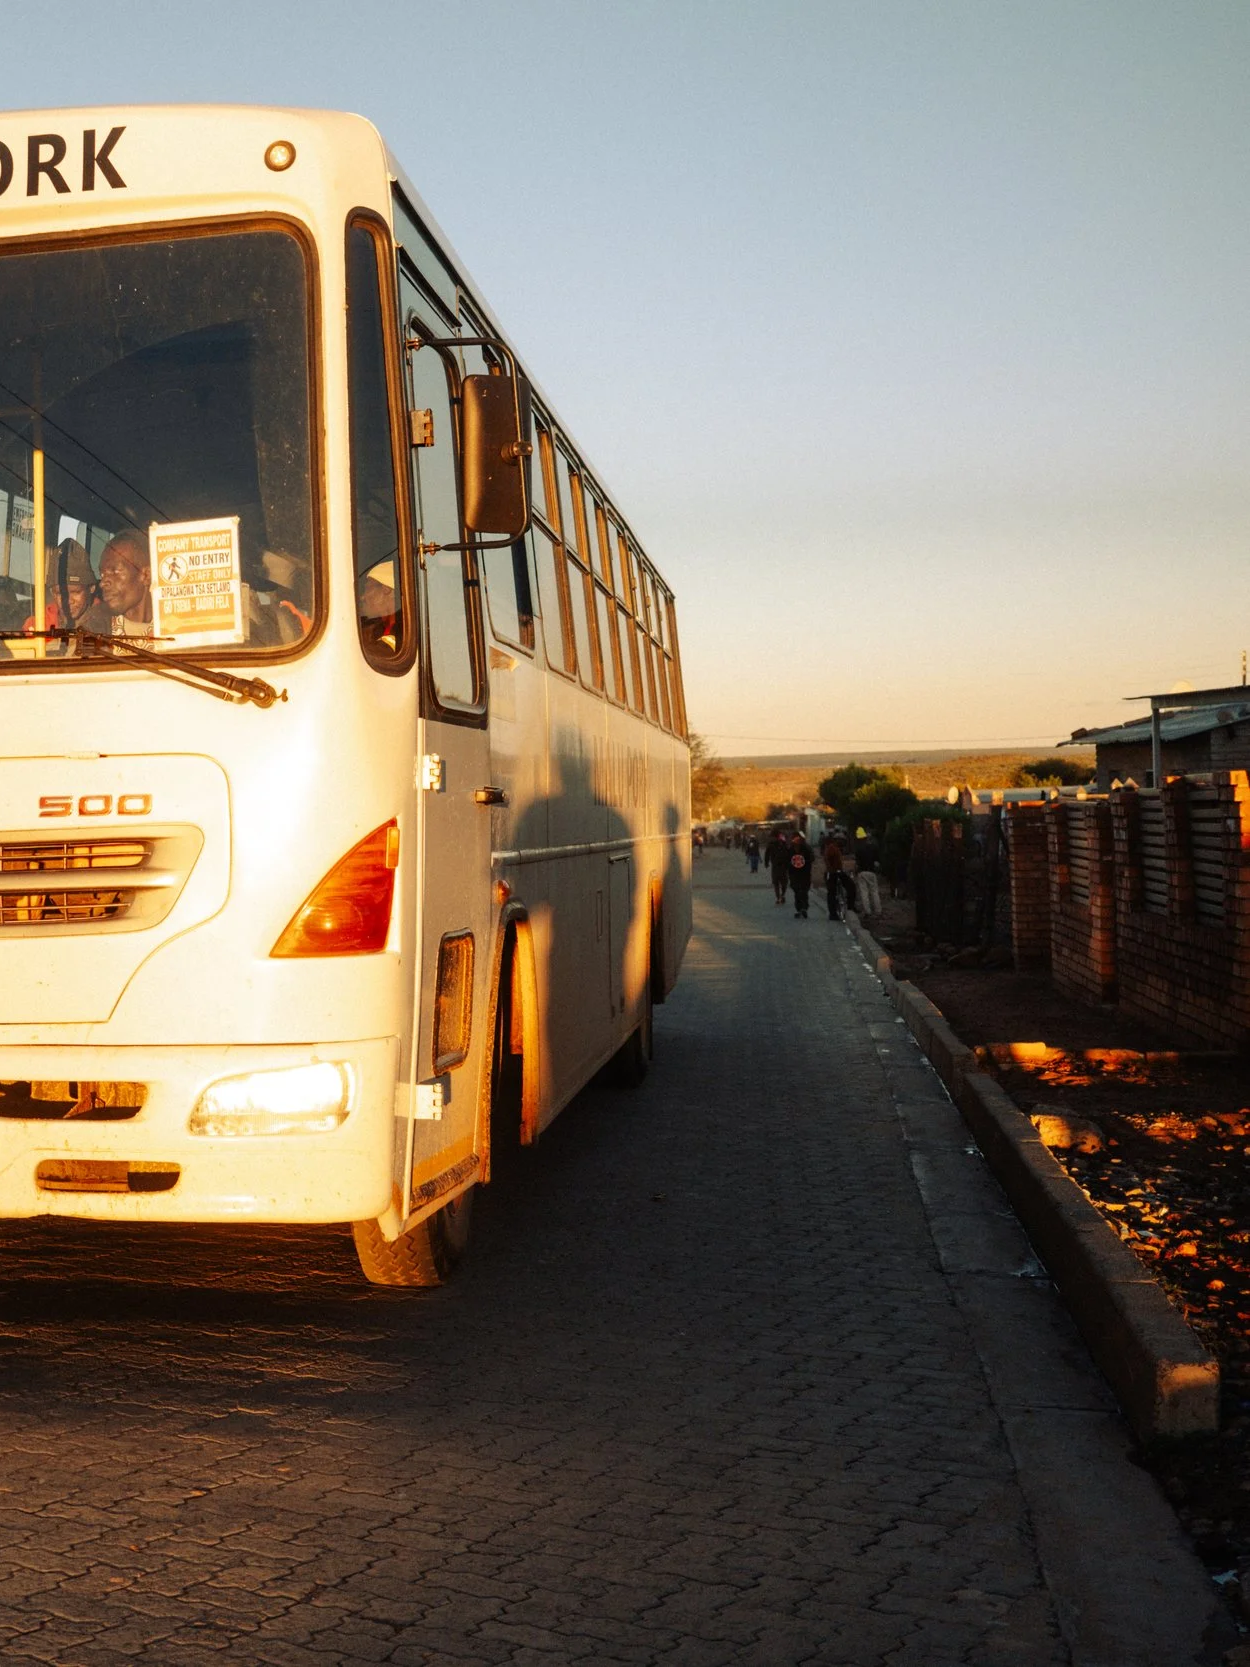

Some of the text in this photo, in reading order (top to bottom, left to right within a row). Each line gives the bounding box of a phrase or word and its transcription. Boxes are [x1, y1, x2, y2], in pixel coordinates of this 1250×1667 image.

[158, 533, 231, 552] COMPANY TRANSPORT
[189, 552, 230, 566] NO ENTRY
[189, 568, 231, 581] STAFF ONLY
[195, 583, 206, 595] TSA
[207, 581, 230, 594] SETLAMO
[38, 793, 153, 818] 500
